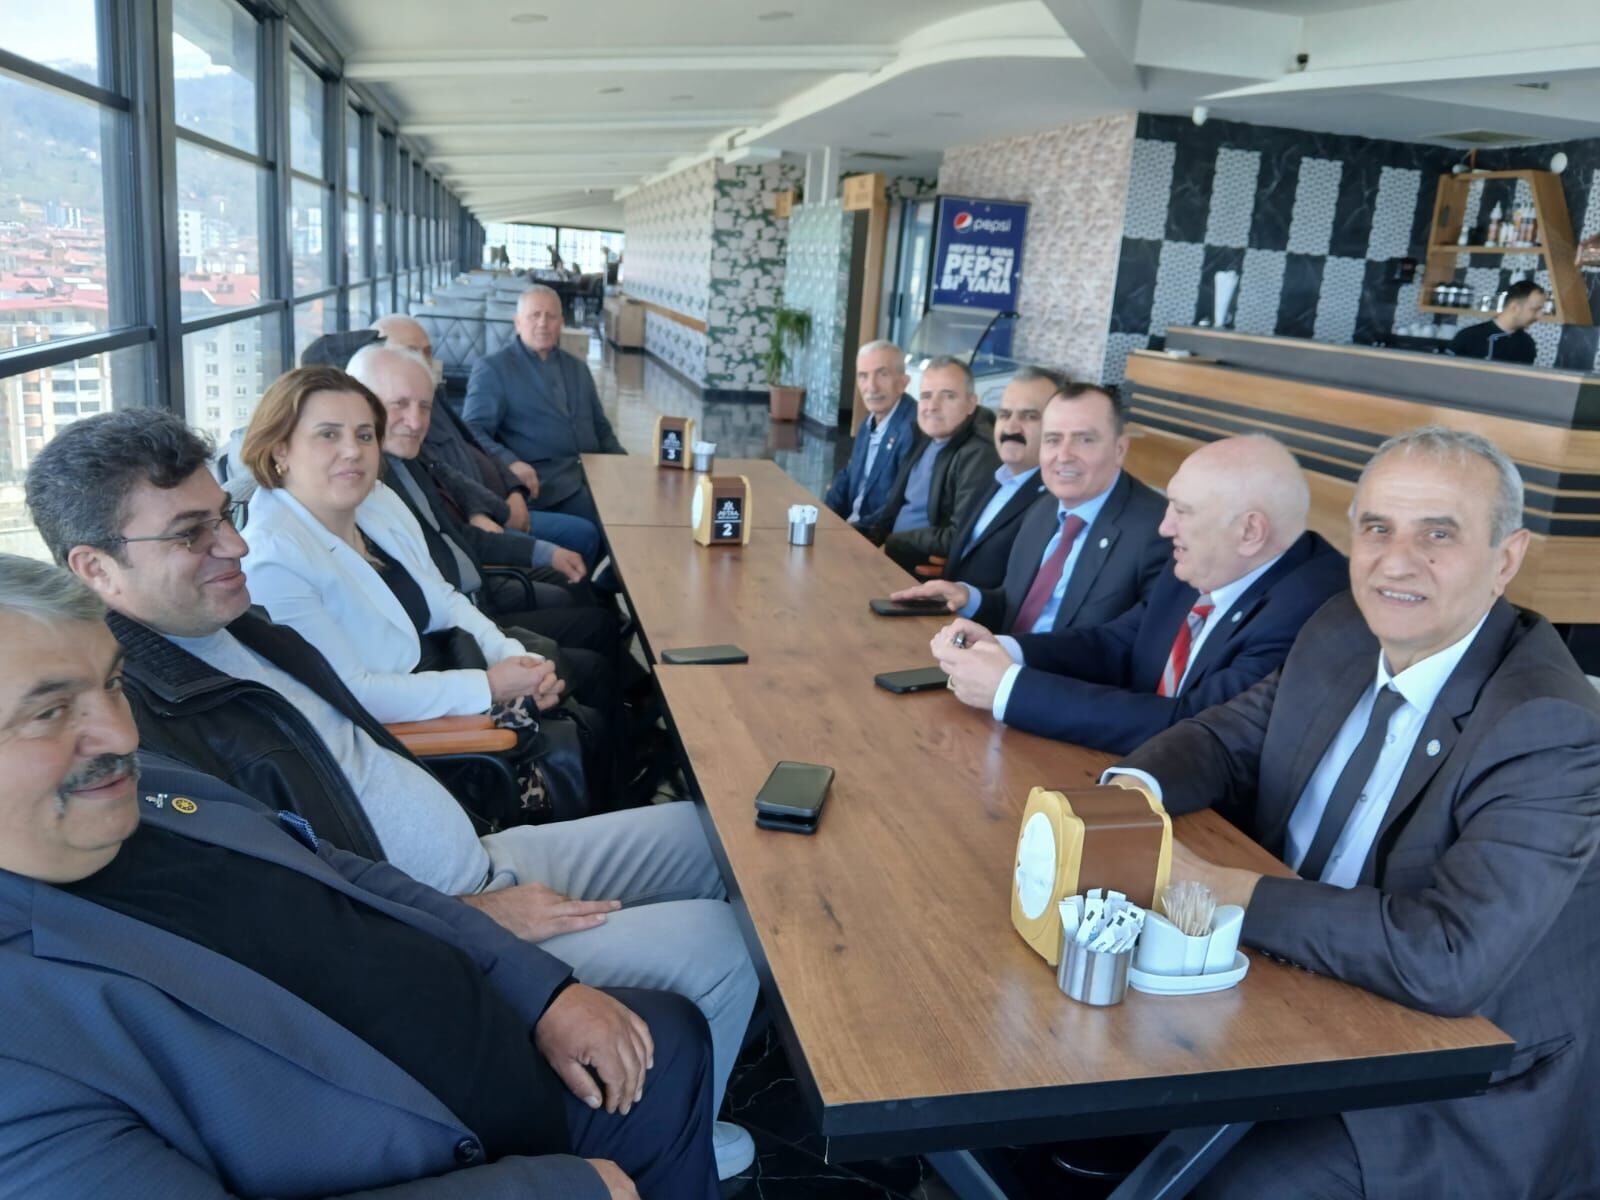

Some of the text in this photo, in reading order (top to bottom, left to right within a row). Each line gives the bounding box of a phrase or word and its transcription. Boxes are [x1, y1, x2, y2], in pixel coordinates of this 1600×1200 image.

[973, 218, 1012, 233] pepsi
[944, 254, 1014, 278] PEPSI
[967, 277, 1011, 294] YANA
[667, 449, 676, 460] 3
[722, 523, 733, 537] 2
